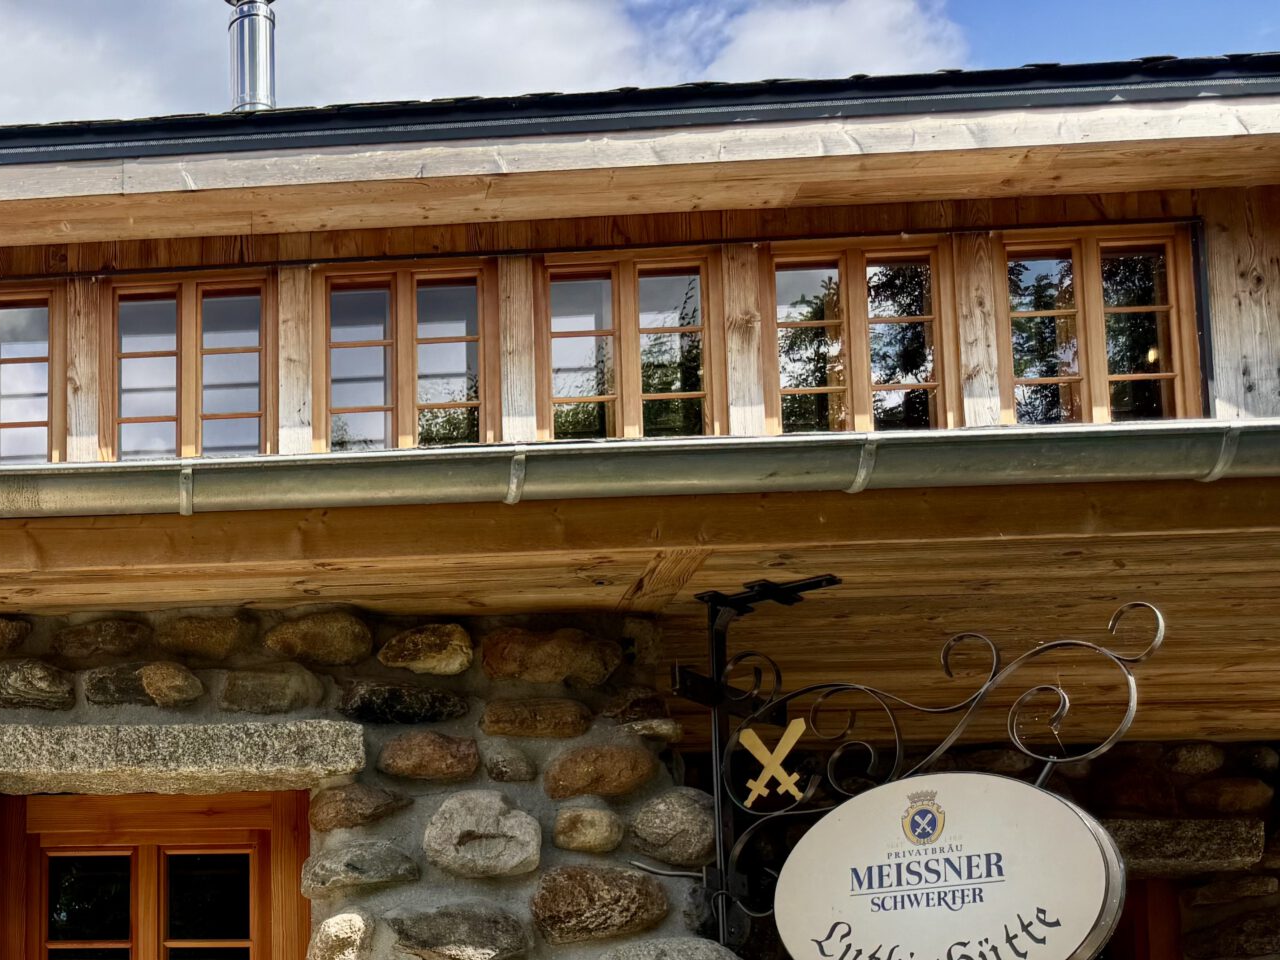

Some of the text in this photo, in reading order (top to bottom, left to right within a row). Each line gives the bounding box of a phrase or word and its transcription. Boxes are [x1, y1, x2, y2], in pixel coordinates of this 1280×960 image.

[887, 843, 963, 860] PRIVATBRÄU
[849, 852, 1005, 892] MEISSNER
[870, 887, 984, 912] SCHWERTER
